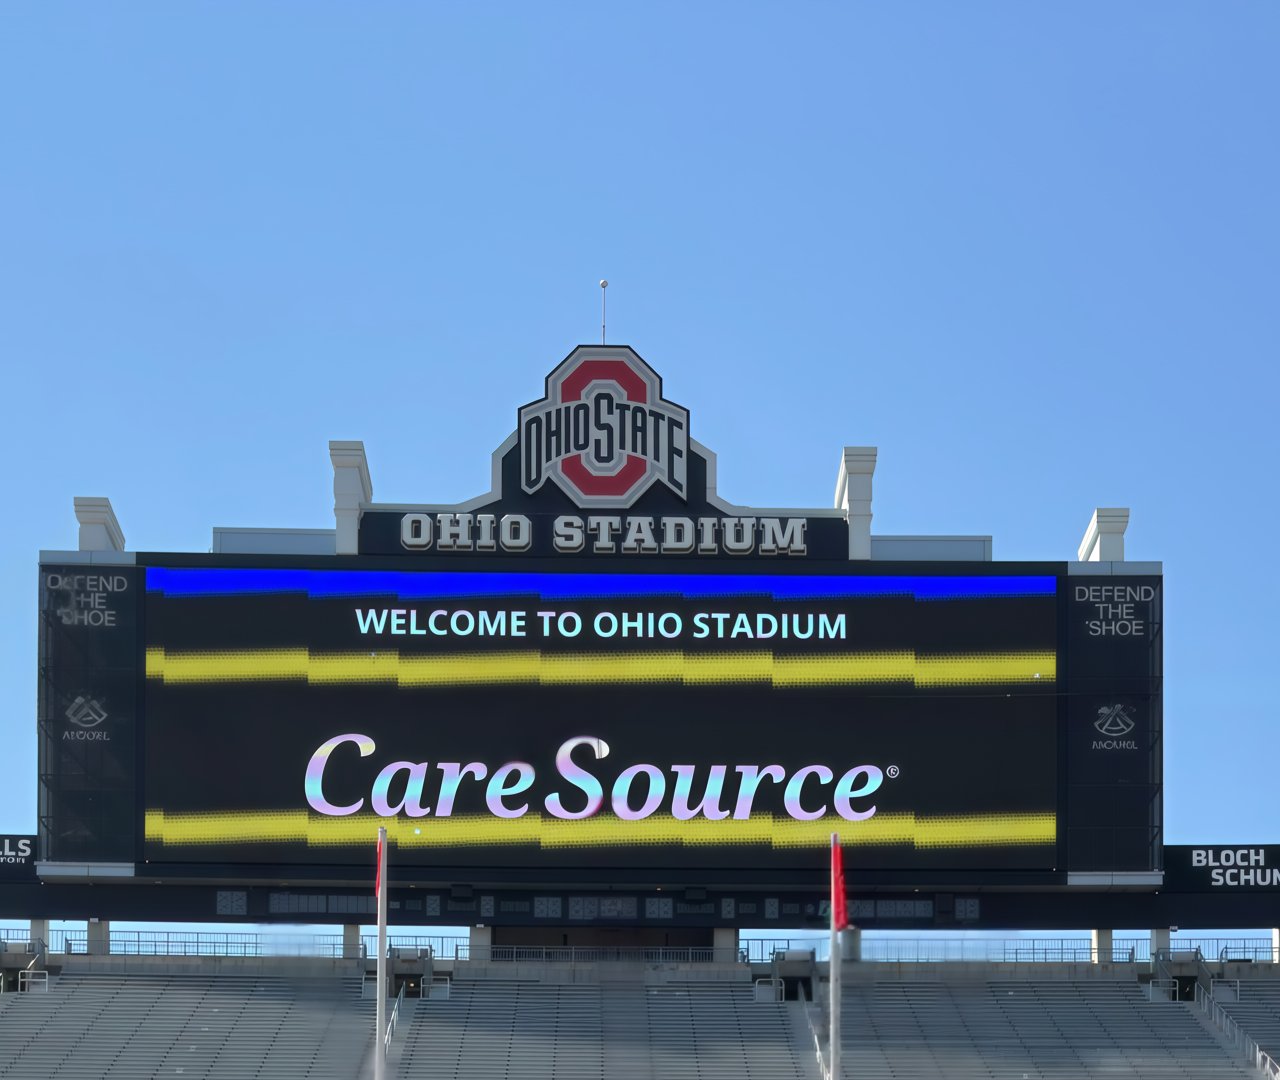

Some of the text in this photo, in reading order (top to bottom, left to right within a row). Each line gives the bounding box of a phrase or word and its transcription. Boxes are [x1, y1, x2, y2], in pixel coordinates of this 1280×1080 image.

[400, 512, 808, 557] OHIO STADIUM
[1075, 586, 1154, 601] DEFEND
[1095, 604, 1134, 619] THE
[354, 609, 848, 641] WELCOME TO OHIO STADIUM
[1192, 849, 1264, 867] BLOCH
